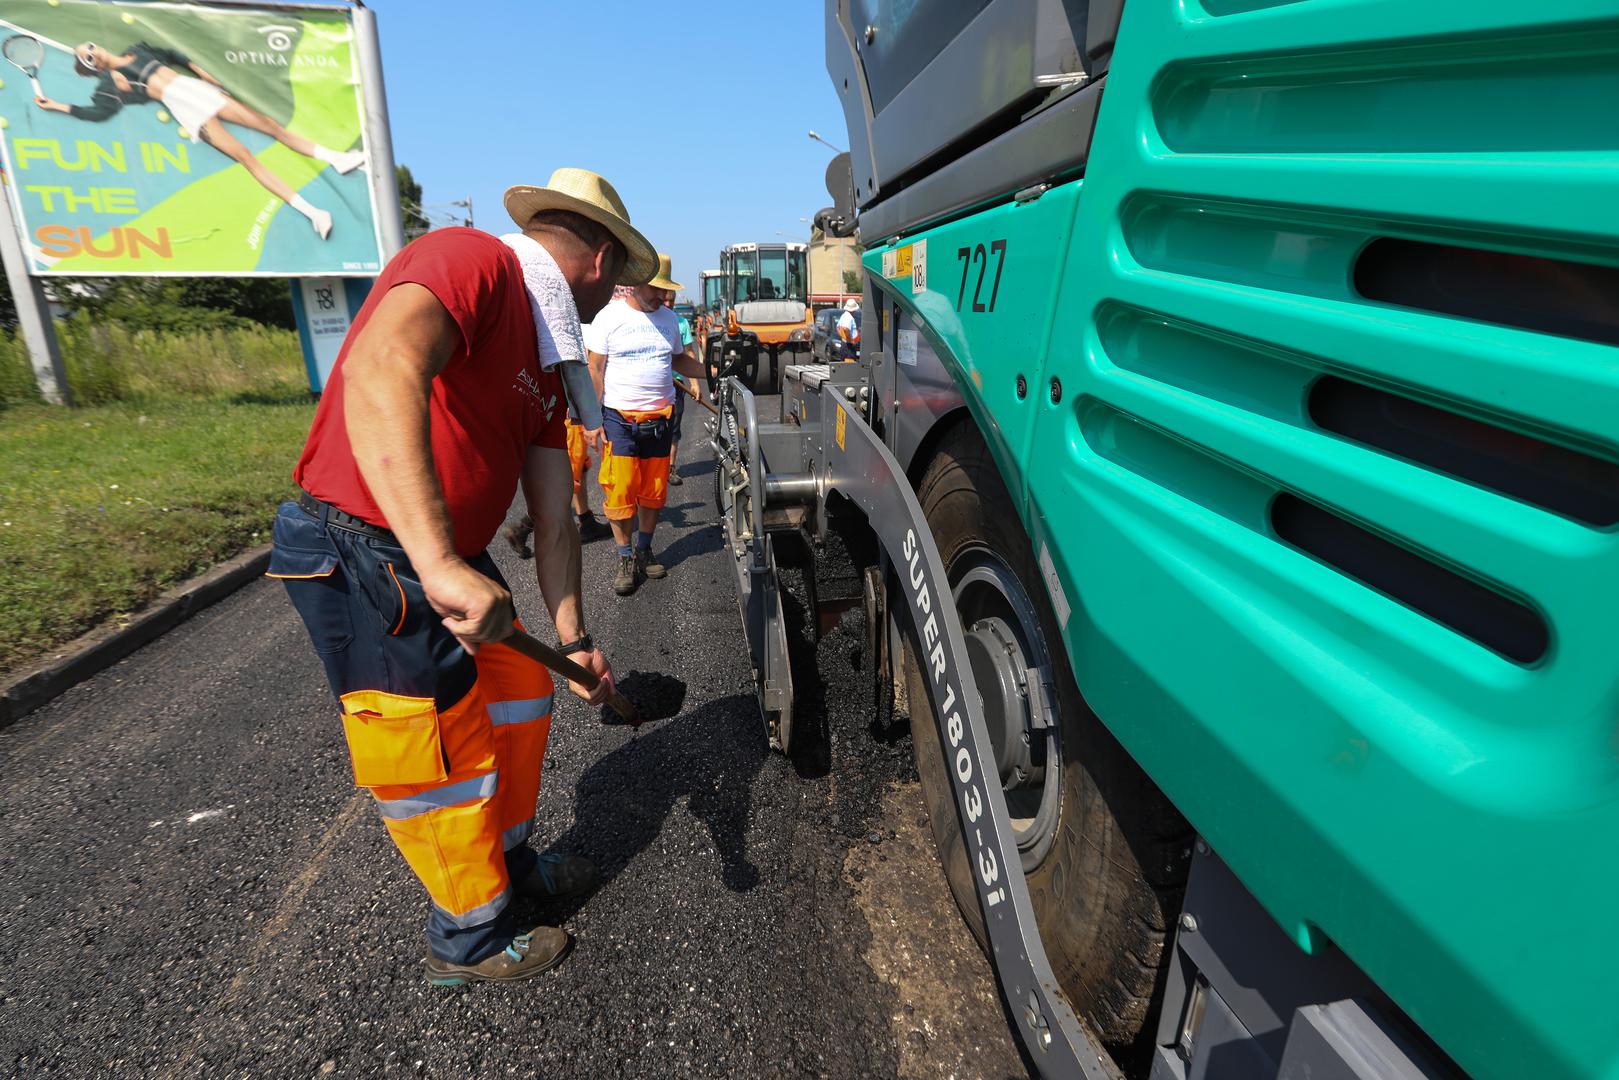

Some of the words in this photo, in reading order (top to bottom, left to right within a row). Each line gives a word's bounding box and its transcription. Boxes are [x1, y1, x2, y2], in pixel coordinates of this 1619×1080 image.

[224, 50, 289, 66] OPTIKA
[294, 53, 340, 68] ANDA
[12, 138, 127, 173] FUN
[140, 142, 191, 173] IN
[24, 185, 140, 214] THE
[35, 225, 173, 260] SUN
[957, 239, 1007, 313] 727
[903, 528, 947, 684] SUPER
[942, 683, 1006, 907] 1803-3i
